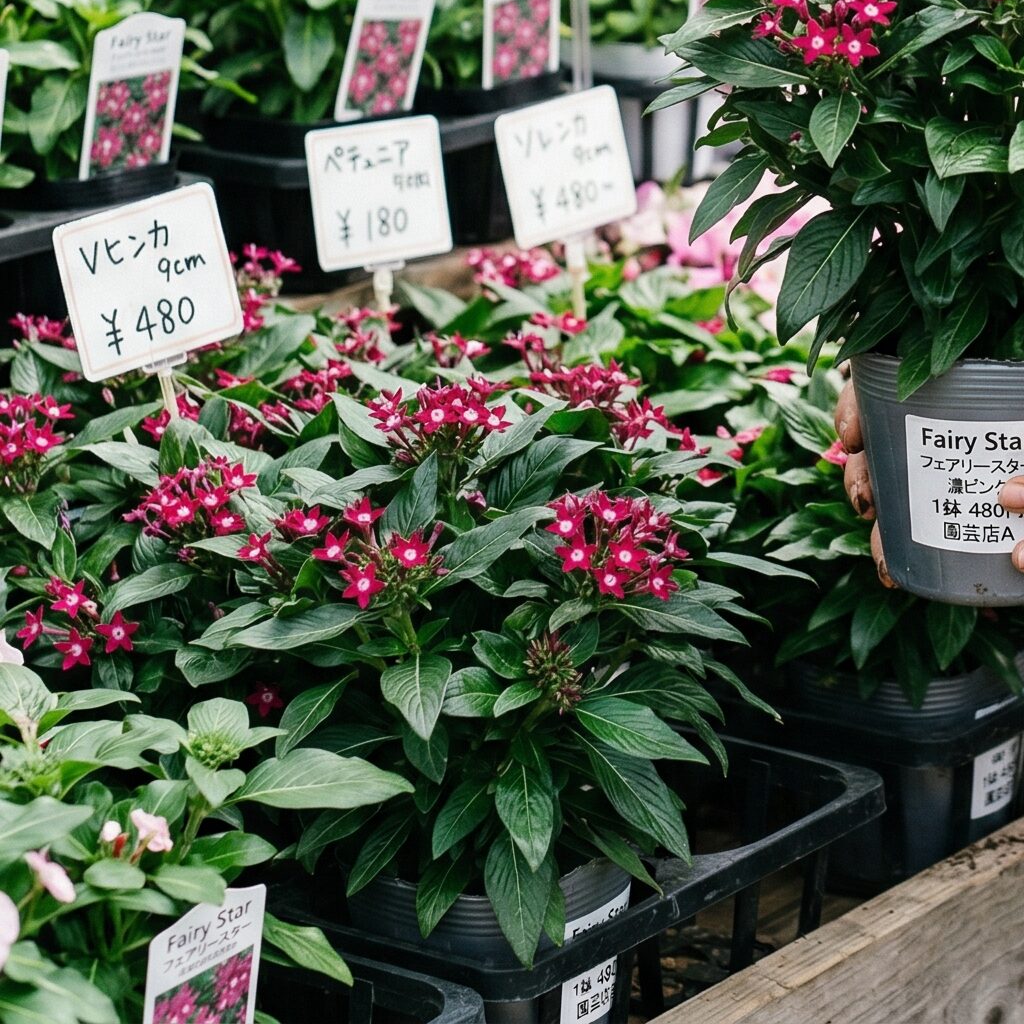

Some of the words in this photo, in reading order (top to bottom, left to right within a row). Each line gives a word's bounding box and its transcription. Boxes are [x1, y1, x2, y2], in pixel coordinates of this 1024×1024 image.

[157, 253, 206, 283] 9cm
[921, 427, 977, 455] Fairy
[968, 502, 1024, 519] 480
[167, 920, 212, 953] Fairy
[216, 900, 252, 929] Star
